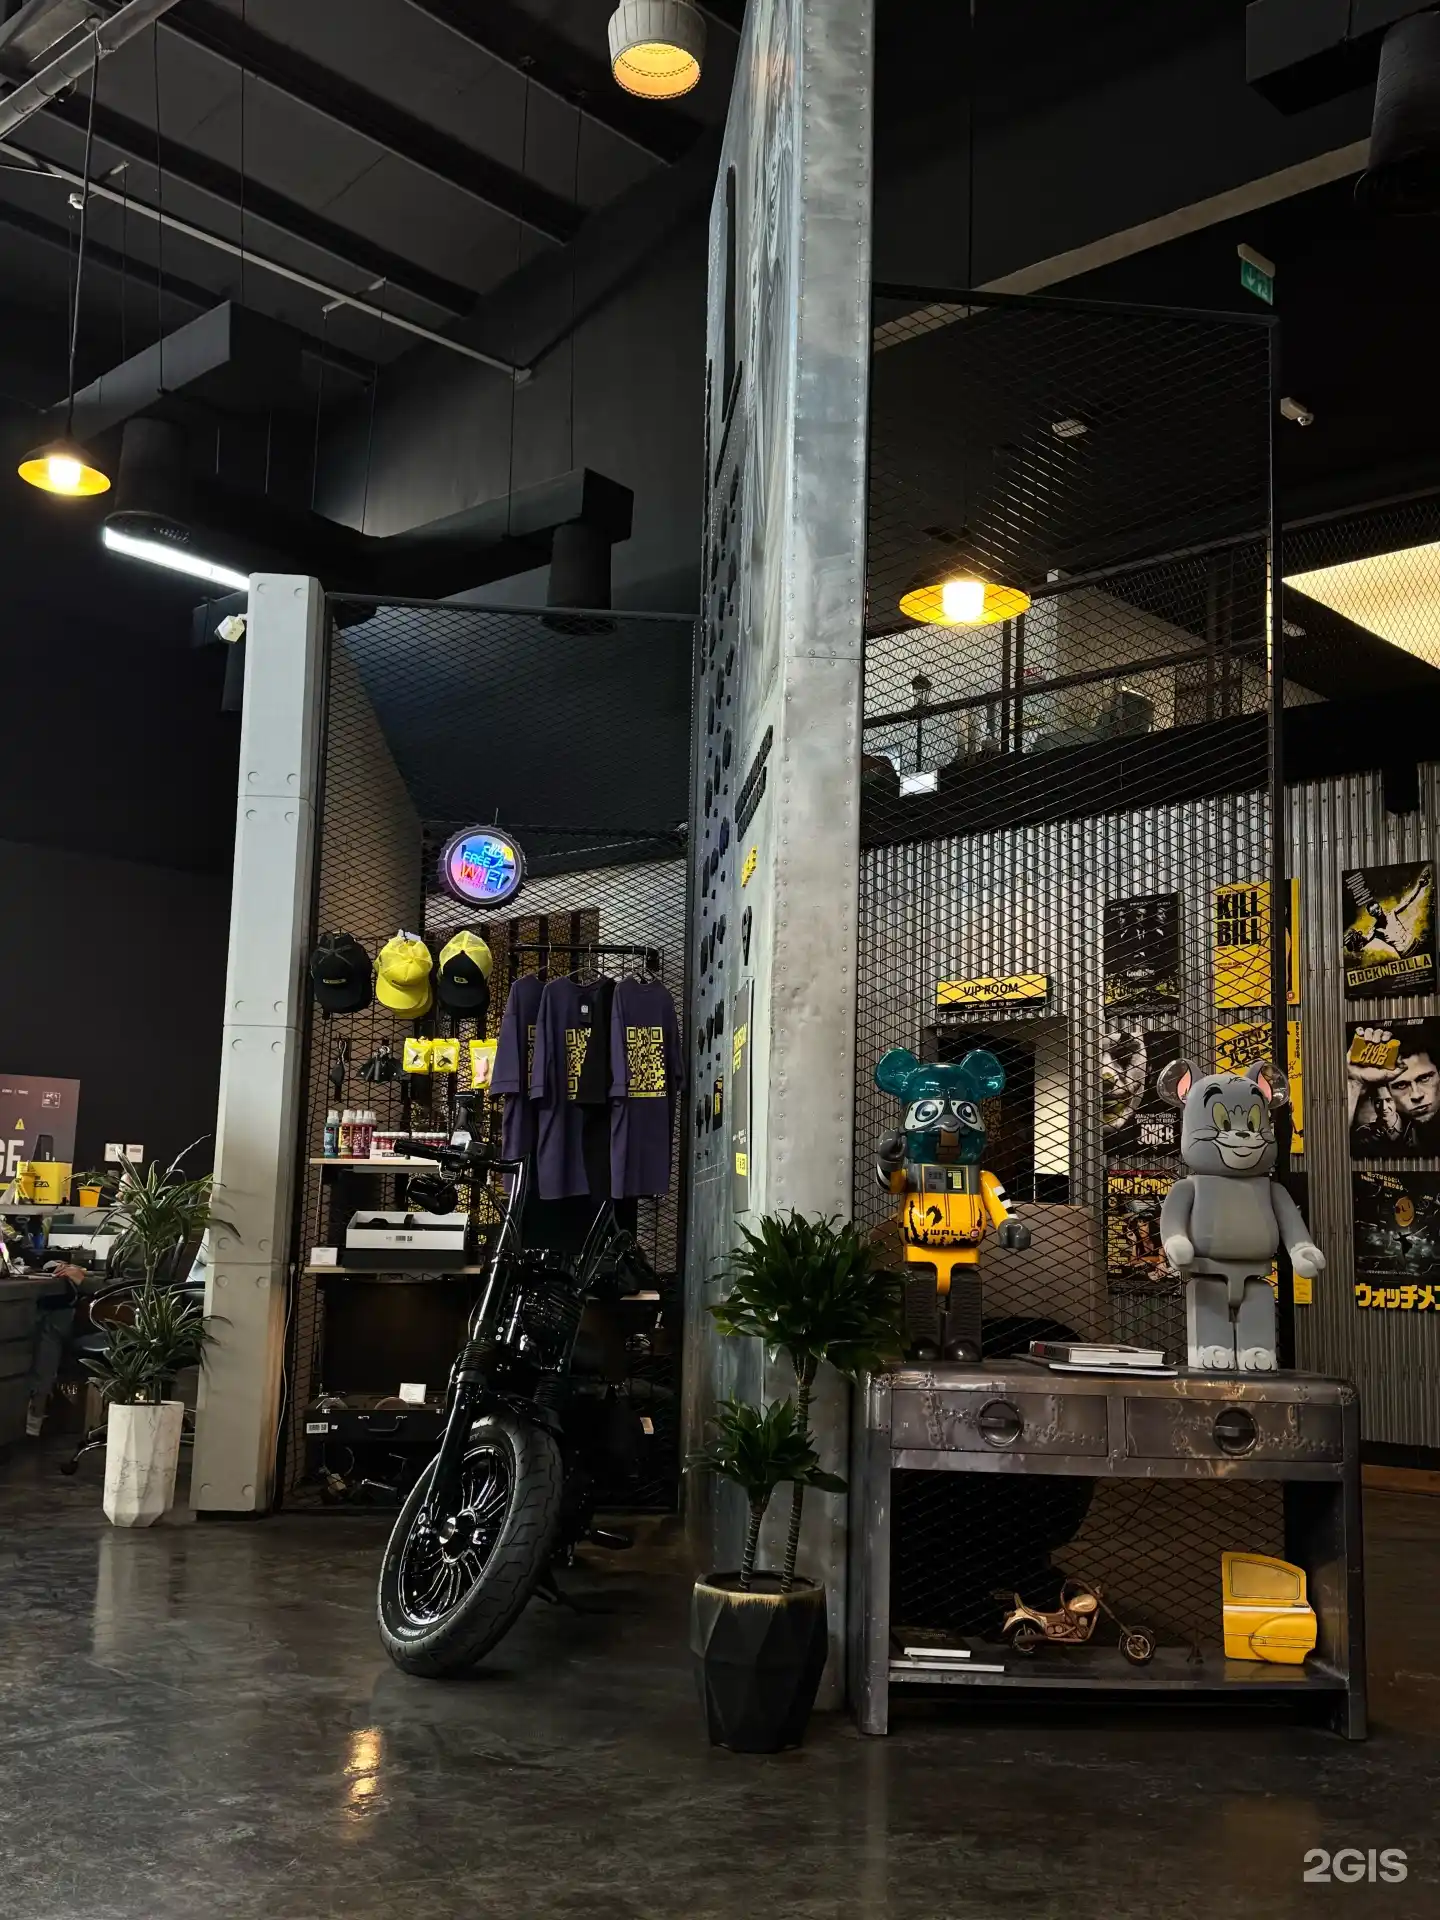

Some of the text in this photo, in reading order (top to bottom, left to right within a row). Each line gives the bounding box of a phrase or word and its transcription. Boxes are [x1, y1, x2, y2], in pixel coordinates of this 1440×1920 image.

[463, 851, 492, 869] FREE
[1217, 892, 1260, 919] KILL
[1217, 918, 1260, 945] BILL
[1348, 955, 1432, 986] ROCKNROLLA
[964, 983, 1018, 995] VIP ROOM
[1360, 1047, 1388, 1066] CLUB
[1137, 1124, 1175, 1145] JOKER
[1107, 1177, 1133, 1194] PULP
